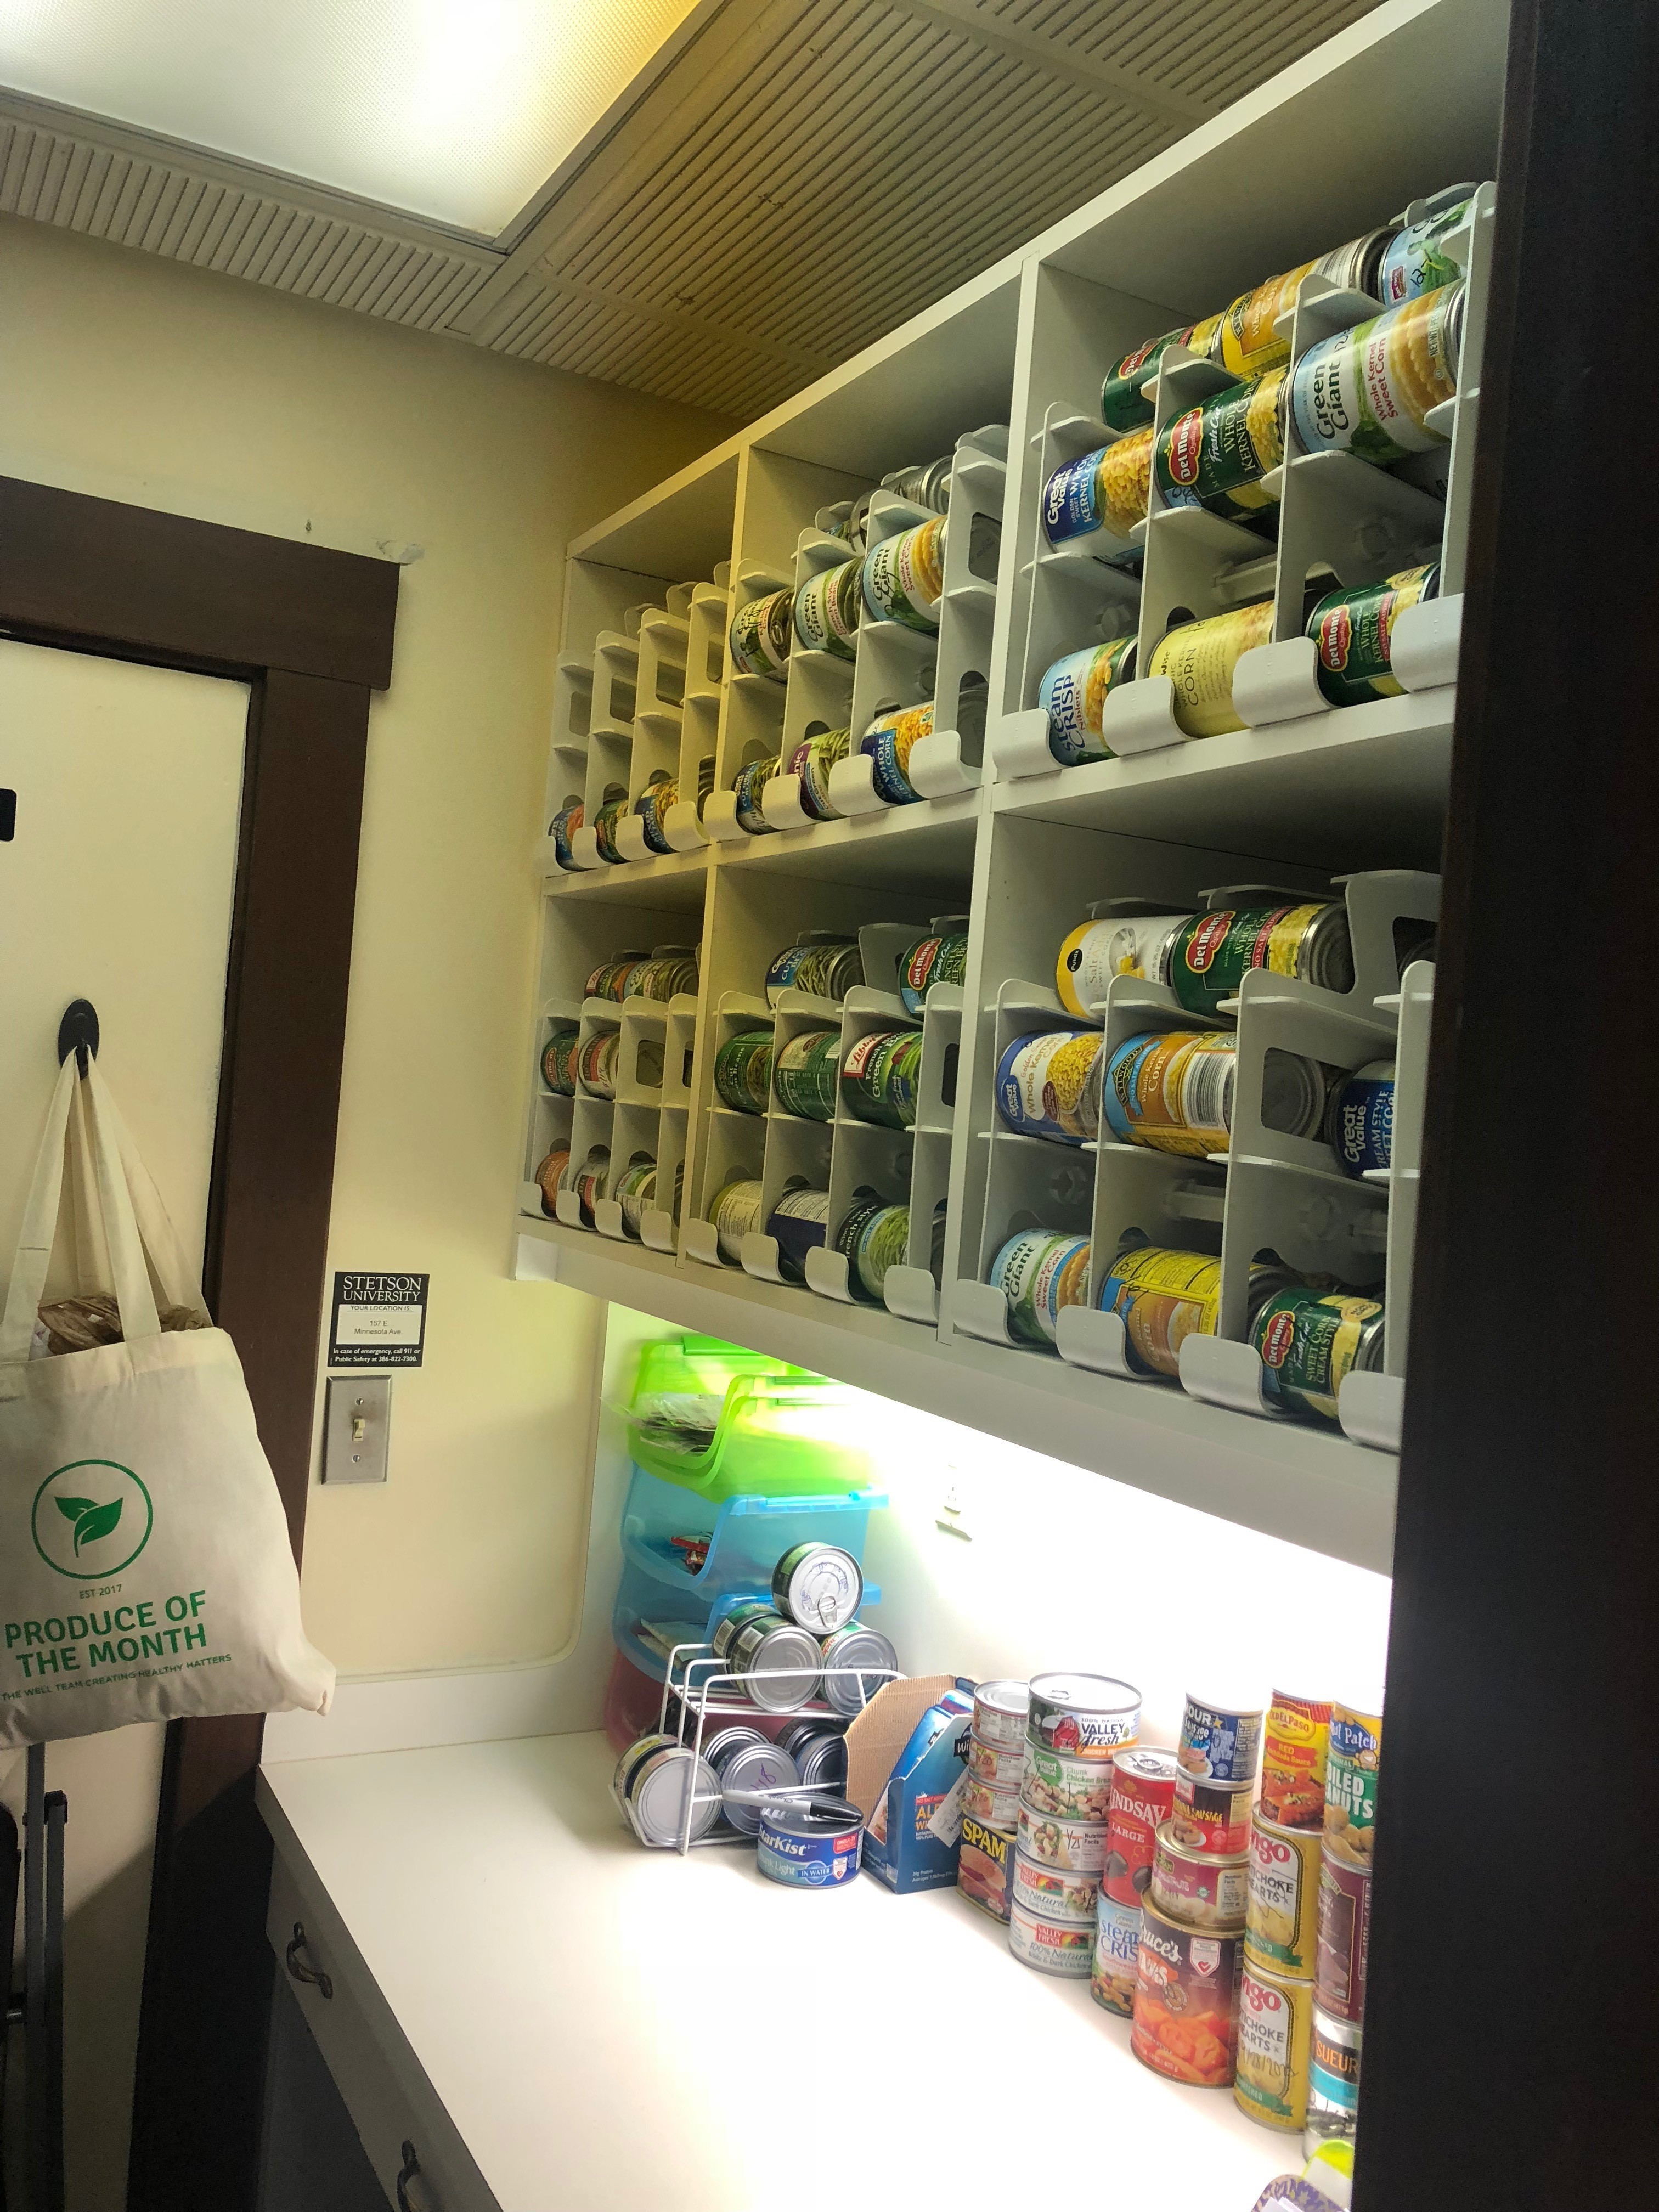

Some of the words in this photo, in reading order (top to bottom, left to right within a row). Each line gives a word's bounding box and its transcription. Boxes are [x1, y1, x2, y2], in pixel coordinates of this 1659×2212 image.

[1367, 341, 1377, 382] Kernel
[1375, 336, 1387, 374] Corn
[1313, 363, 1335, 439] Green
[1326, 359, 1350, 431] Giant
[1369, 383, 1388, 421] Whole
[1377, 376, 1399, 419] Sweet
[1210, 404, 1224, 429] Cut
[1223, 399, 1240, 454] WHOLE
[1177, 411, 1197, 456] Monte
[1188, 424, 1198, 455] Quality
[1207, 428, 1223, 462] Fresh
[1235, 413, 1256, 473] KERNEL
[1178, 456, 1192, 480] Del
[1203, 455, 1220, 489] MADE
[1047, 470, 1066, 524] Great
[1057, 468, 1073, 509] Value
[1080, 477, 1092, 523] KERNEL
[905, 535, 915, 558] Corn
[873, 548, 885, 601] Green
[879, 548, 890, 596] Giant
[900, 566, 909, 592] Whole
[905, 561, 915, 591] Sweet
[804, 593, 818, 642] Green
[811, 592, 823, 638] Giant
[827, 606, 842, 635] French
[833, 608, 847, 634] Green
[1371, 594, 1385, 620] CORN
[1328, 609, 1342, 646] Monte
[1360, 611, 1371, 649] WHOLE
[1370, 619, 1384, 663] KERNEL
[1329, 648, 1340, 667] Del
[1178, 670, 1188, 708] WHOLE
[1184, 648, 1199, 706] CORN
[1062, 674, 1085, 748] CRISP
[1075, 690, 1086, 730] Niblets
[878, 736, 890, 783] WHOLE
[811, 767, 819, 795] Green
[1199, 911, 1228, 944] Monte
[1209, 923, 1226, 948] Quality
[1234, 918, 1258, 955] WHOLE
[1257, 932, 1266, 954] SALT
[916, 940, 935, 967] Monte
[933, 958, 943, 982] Fresh
[941, 942, 951, 958] Cut
[1071, 950, 1079, 971] Publix
[1194, 945, 1207, 967] Del
[1242, 929, 1257, 975] KERNEL
[1255, 956, 1261, 968] NO
[782, 960, 793, 980] CUT
[913, 968, 922, 985] Del
[865, 1046, 882, 1081] French
[1030, 1037, 1058, 1069] Kernel
[1043, 1037, 1064, 1058] Corn
[872, 1051, 888, 1098] Green
[1020, 1053, 1034, 1078] Golden
[1118, 1046, 1143, 1102] WYLWOOD
[1141, 1074, 1149, 1103] Whole
[1147, 1046, 1164, 1072] Kernel
[1148, 1055, 1166, 1092] Corn
[1006, 1084, 1018, 1117] Great
[1011, 1084, 1020, 1113] Value
[1026, 1071, 1036, 1114] Whole
[1372, 1090, 1389, 1127] STYLE
[1344, 1104, 1360, 1163] Great
[1354, 1104, 1367, 1151] Value
[1000, 1243, 1028, 1297] Green
[1010, 1243, 1036, 1298] Giant
[1040, 1249, 1059, 1275] Kernel
[343, 1276, 422, 1291] STETSON
[343, 1290, 421, 1302] UNIVERSITY
[1041, 1276, 1051, 1310] Sweet
[1047, 1250, 1066, 1273] Corn
[1271, 1313, 1289, 1346] Monte
[1299, 1321, 1311, 1342] Cut
[1268, 1346, 1278, 1363] Del
[1306, 1346, 1319, 1382] SWEET
[1317, 1346, 1329, 1384] CREAM
[1323, 1318, 1341, 1345] STYLE
[78, 1588, 97, 1600] EST
[98, 1584, 122, 1598] 2017
[4, 1601, 157, 1649] PRODUCE
[165, 1590, 206, 1622] OF
[16, 1645, 82, 1678] THE
[89, 1622, 207, 1668] MONTH
[1, 1690, 22, 1701] THE
[25, 1685, 53, 1697] WELL
[55, 1680, 83, 1691] TEAM
[85, 1671, 137, 1688] CREATING
[137, 1664, 183, 1679] HEALTHY
[186, 1654, 232, 1669] MATTERS
[1081, 1723, 1125, 1735] VALLEY
[1082, 1733, 1120, 1746] fresh
[1344, 1726, 1378, 1751] Patch
[1036, 1756, 1057, 1771] Great
[1278, 1743, 1295, 1754] RED
[1066, 1767, 1088, 1775] Chunk
[1066, 1774, 1094, 1782] Chicken
[758, 1824, 807, 1857] StarKist
[962, 1816, 1007, 1864] SPAM
[1112, 1821, 1146, 1843] LARGE
[774, 1861, 795, 1876] Light
[810, 1867, 831, 1876] WATER
[1029, 1891, 1068, 1908] Natural
[1040, 1905, 1061, 1916] Chicken
[1037, 1925, 1063, 1938] VALLEY
[1038, 1934, 1060, 1946] FRESH
[1030, 1942, 1051, 1956] 100%
[1052, 1949, 1092, 1961] Natural
[1049, 1958, 1063, 1966] Dark
[1316, 2040, 1357, 2074] SUEUR
